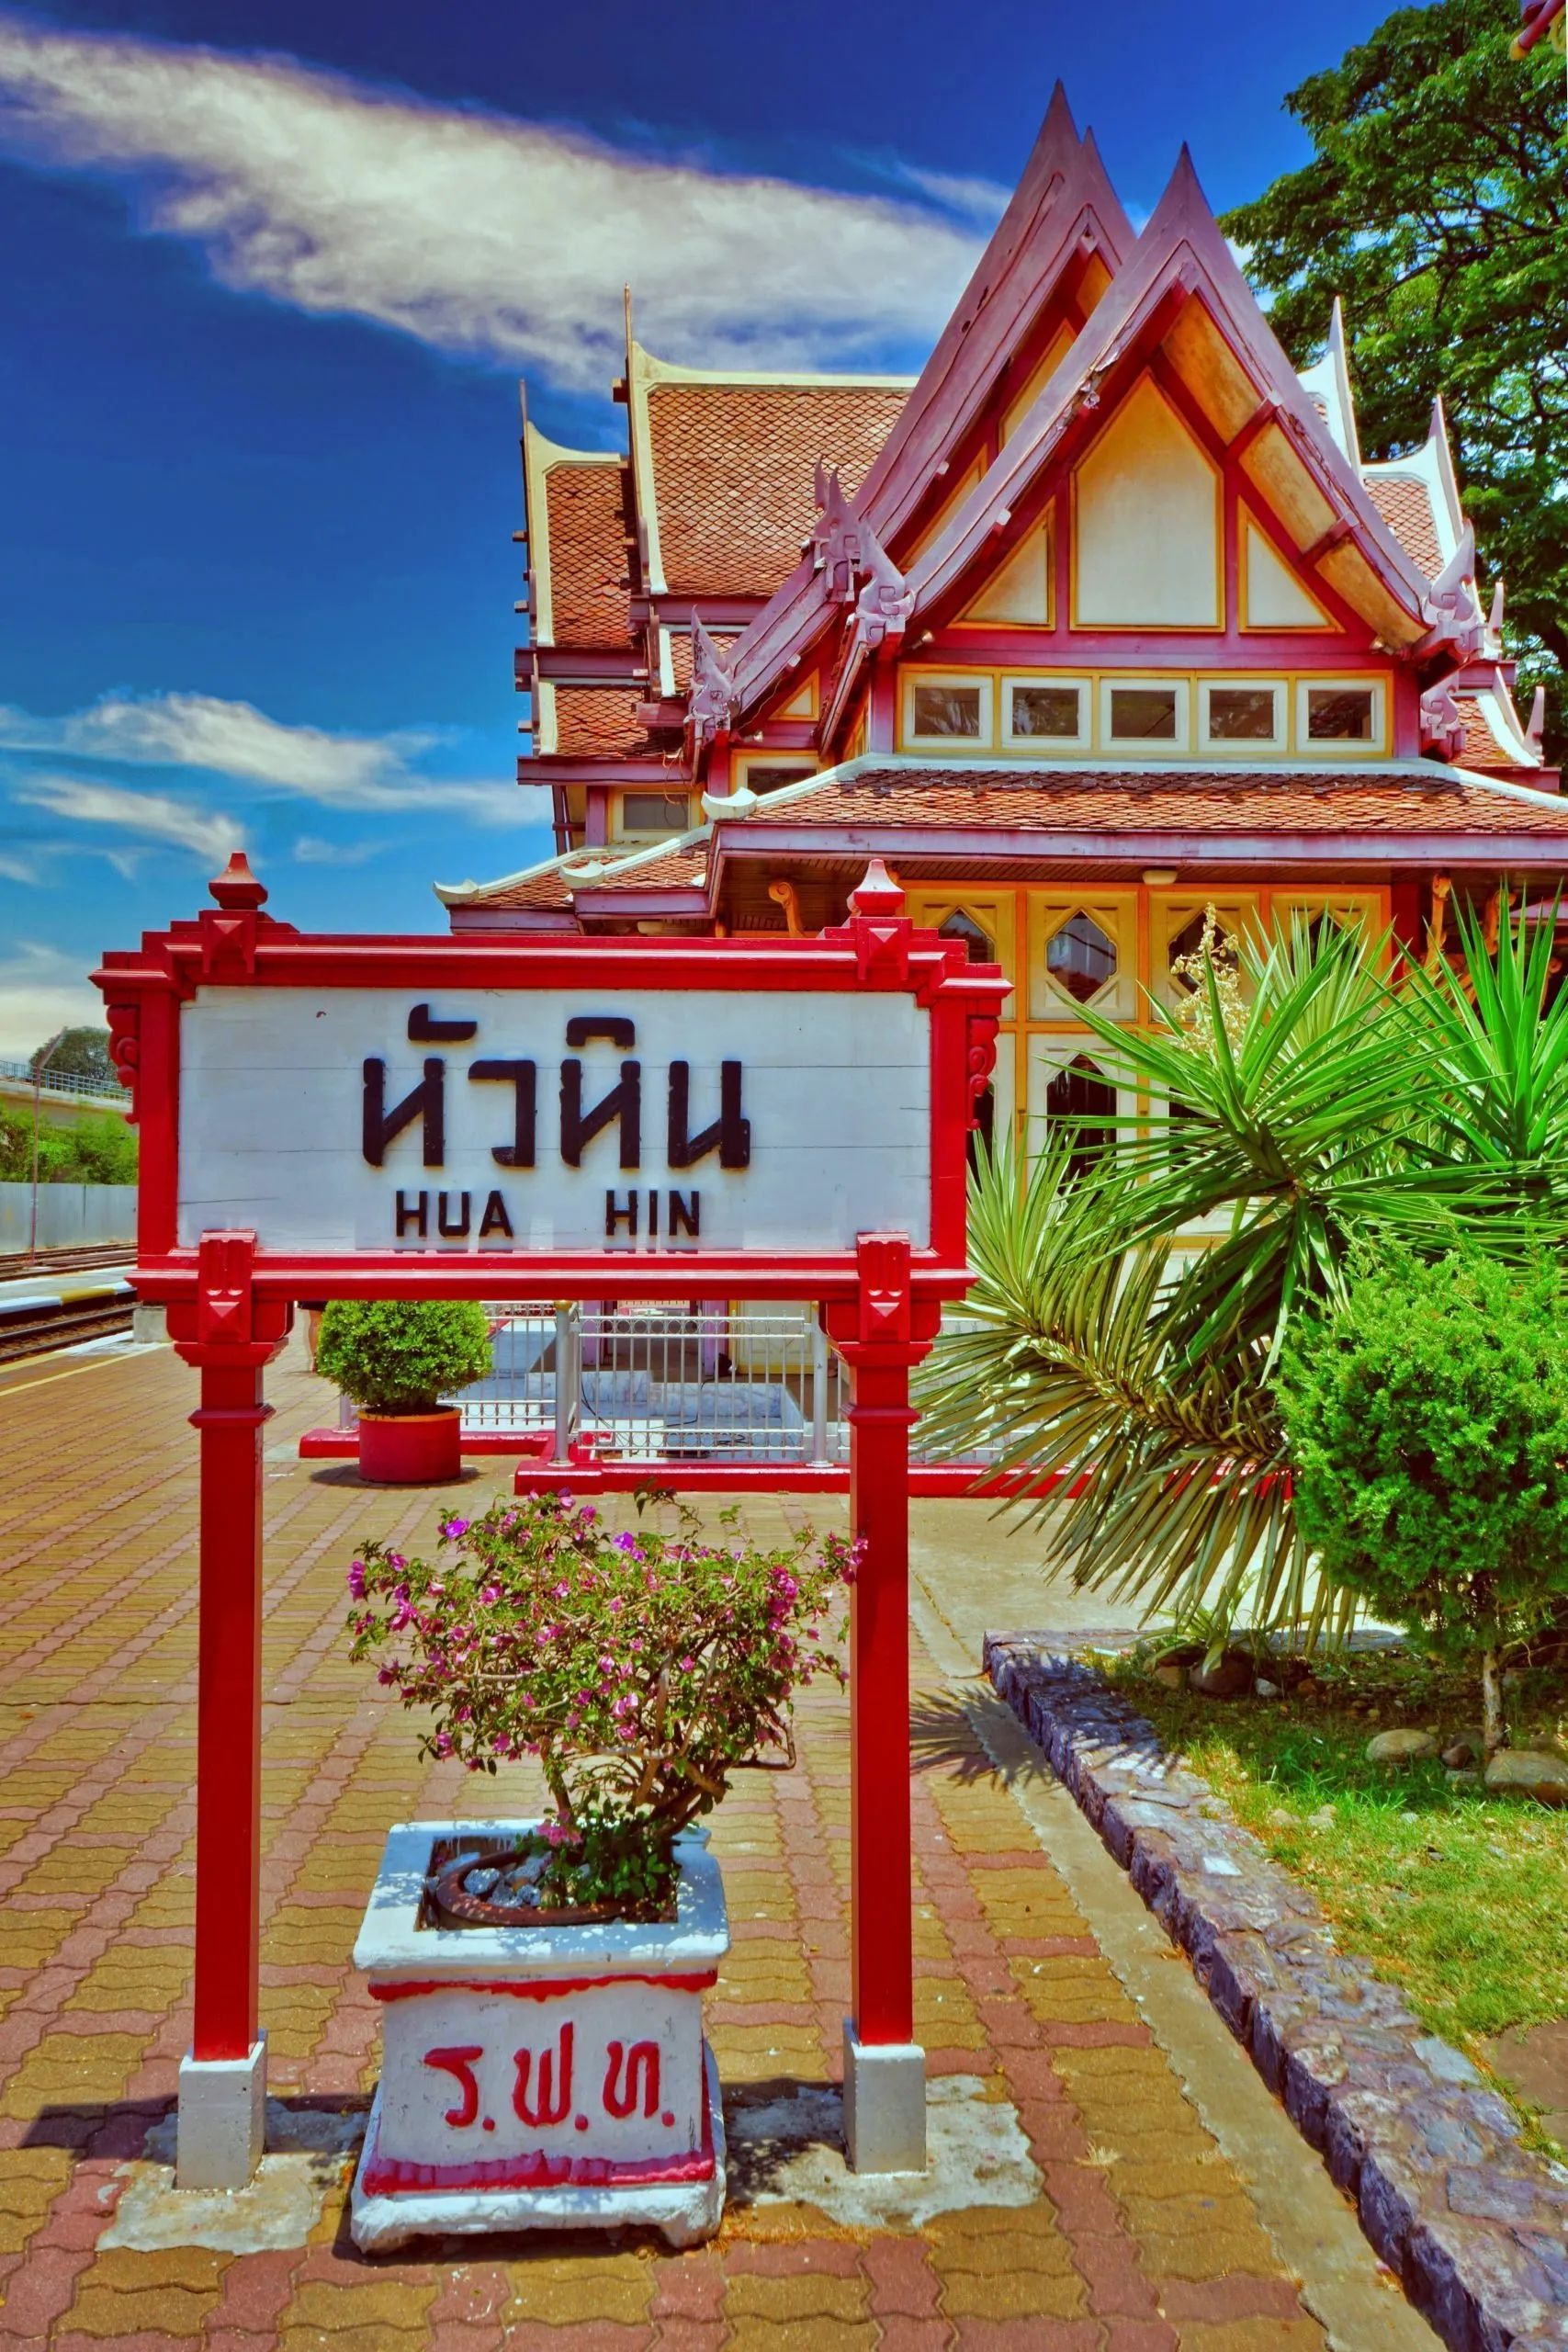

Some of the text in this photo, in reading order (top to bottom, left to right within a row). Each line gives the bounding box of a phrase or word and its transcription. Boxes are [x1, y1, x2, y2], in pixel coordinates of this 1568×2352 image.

[363, 1003, 751, 1170] หัวหิน
[396, 1190, 700, 1238] HUA HIN
[423, 2021, 675, 2132] ร.ฟ.ท.
